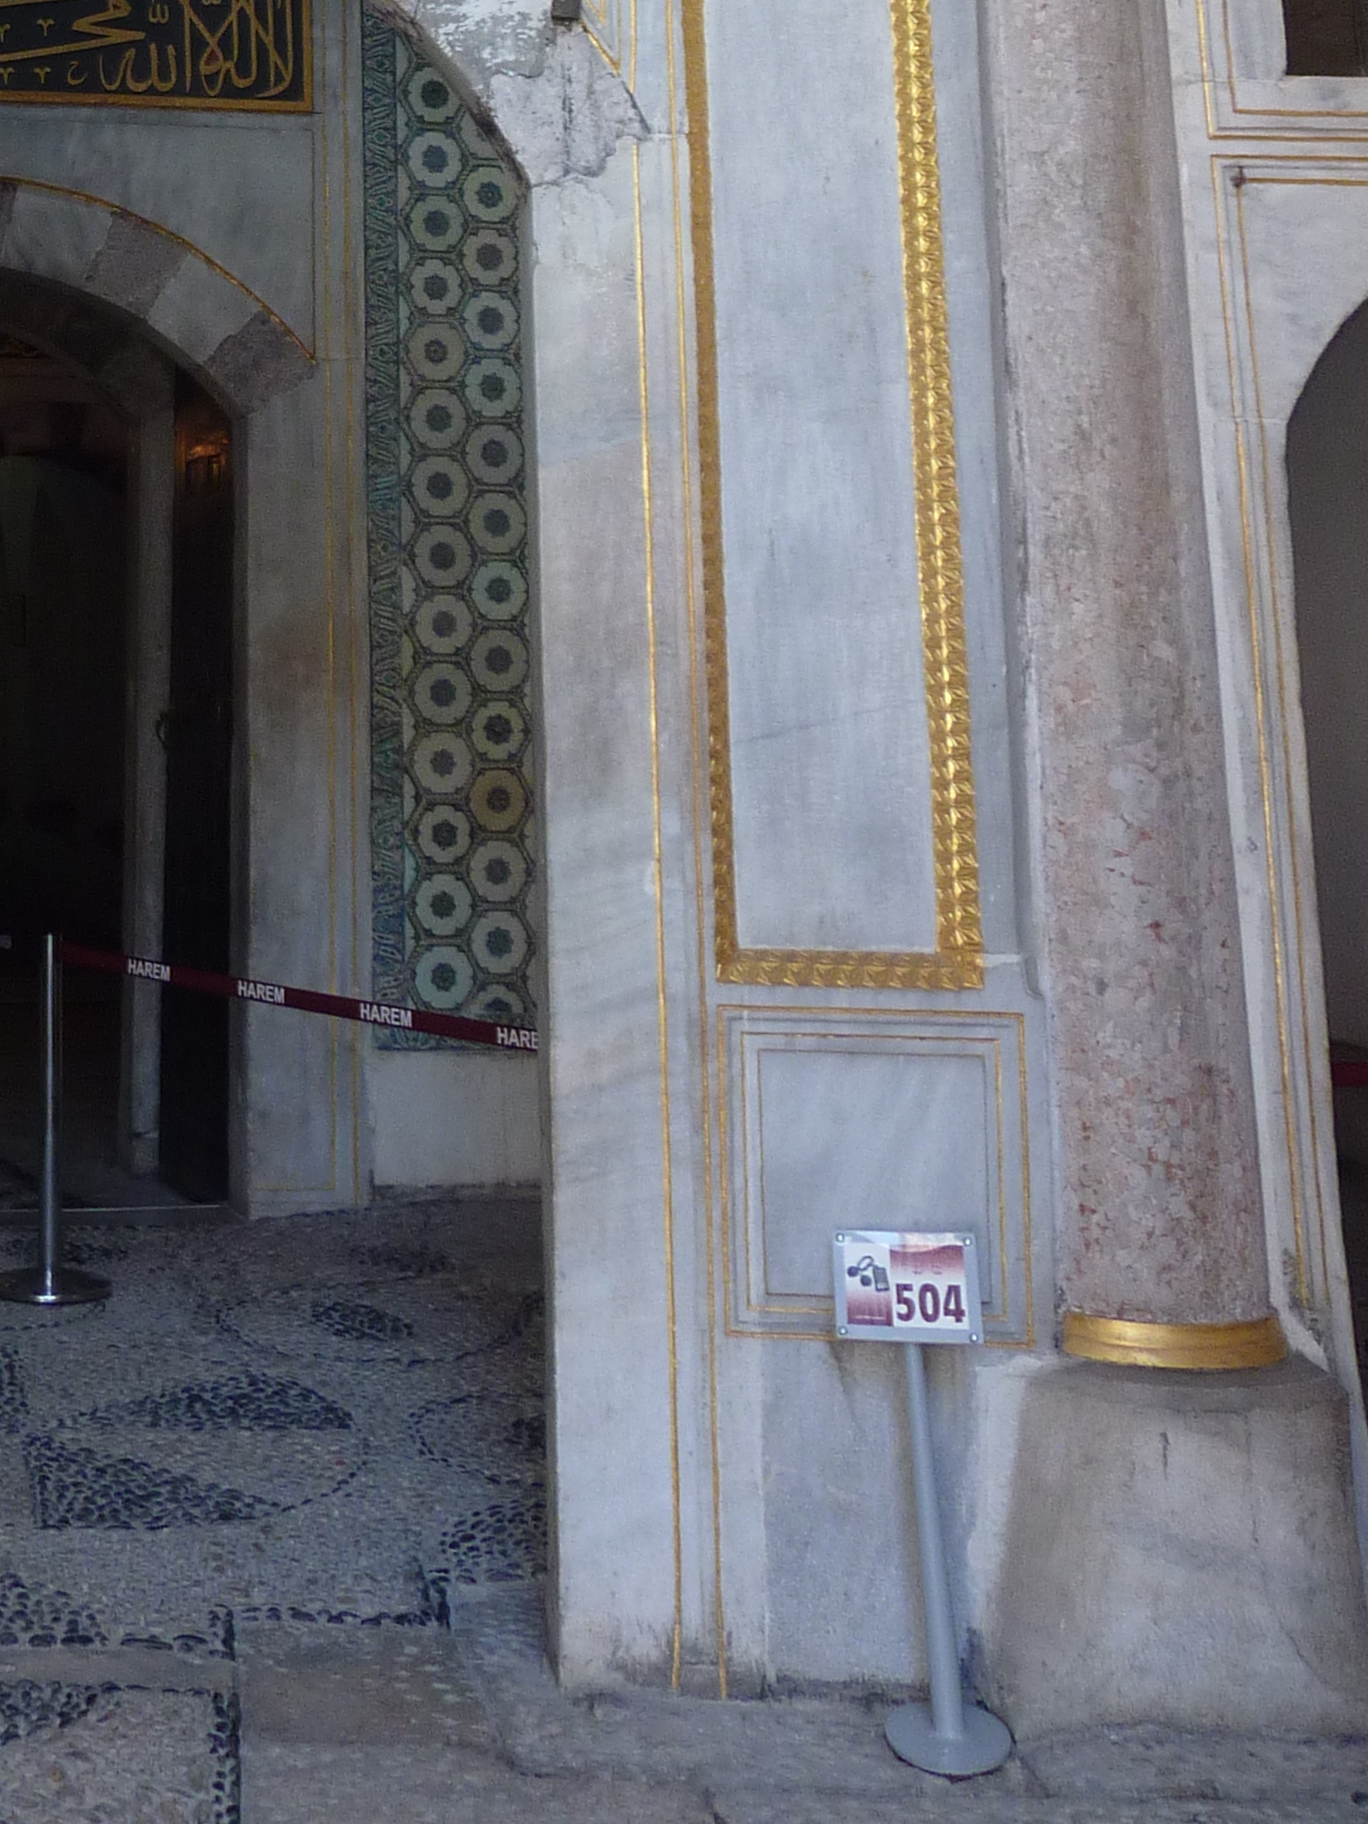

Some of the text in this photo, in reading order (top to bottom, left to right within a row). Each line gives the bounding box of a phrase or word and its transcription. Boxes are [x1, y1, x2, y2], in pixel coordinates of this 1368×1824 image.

[127, 958, 539, 1049] HAREM HAREM HAREM HARE
[895, 1282, 967, 1324] 504
